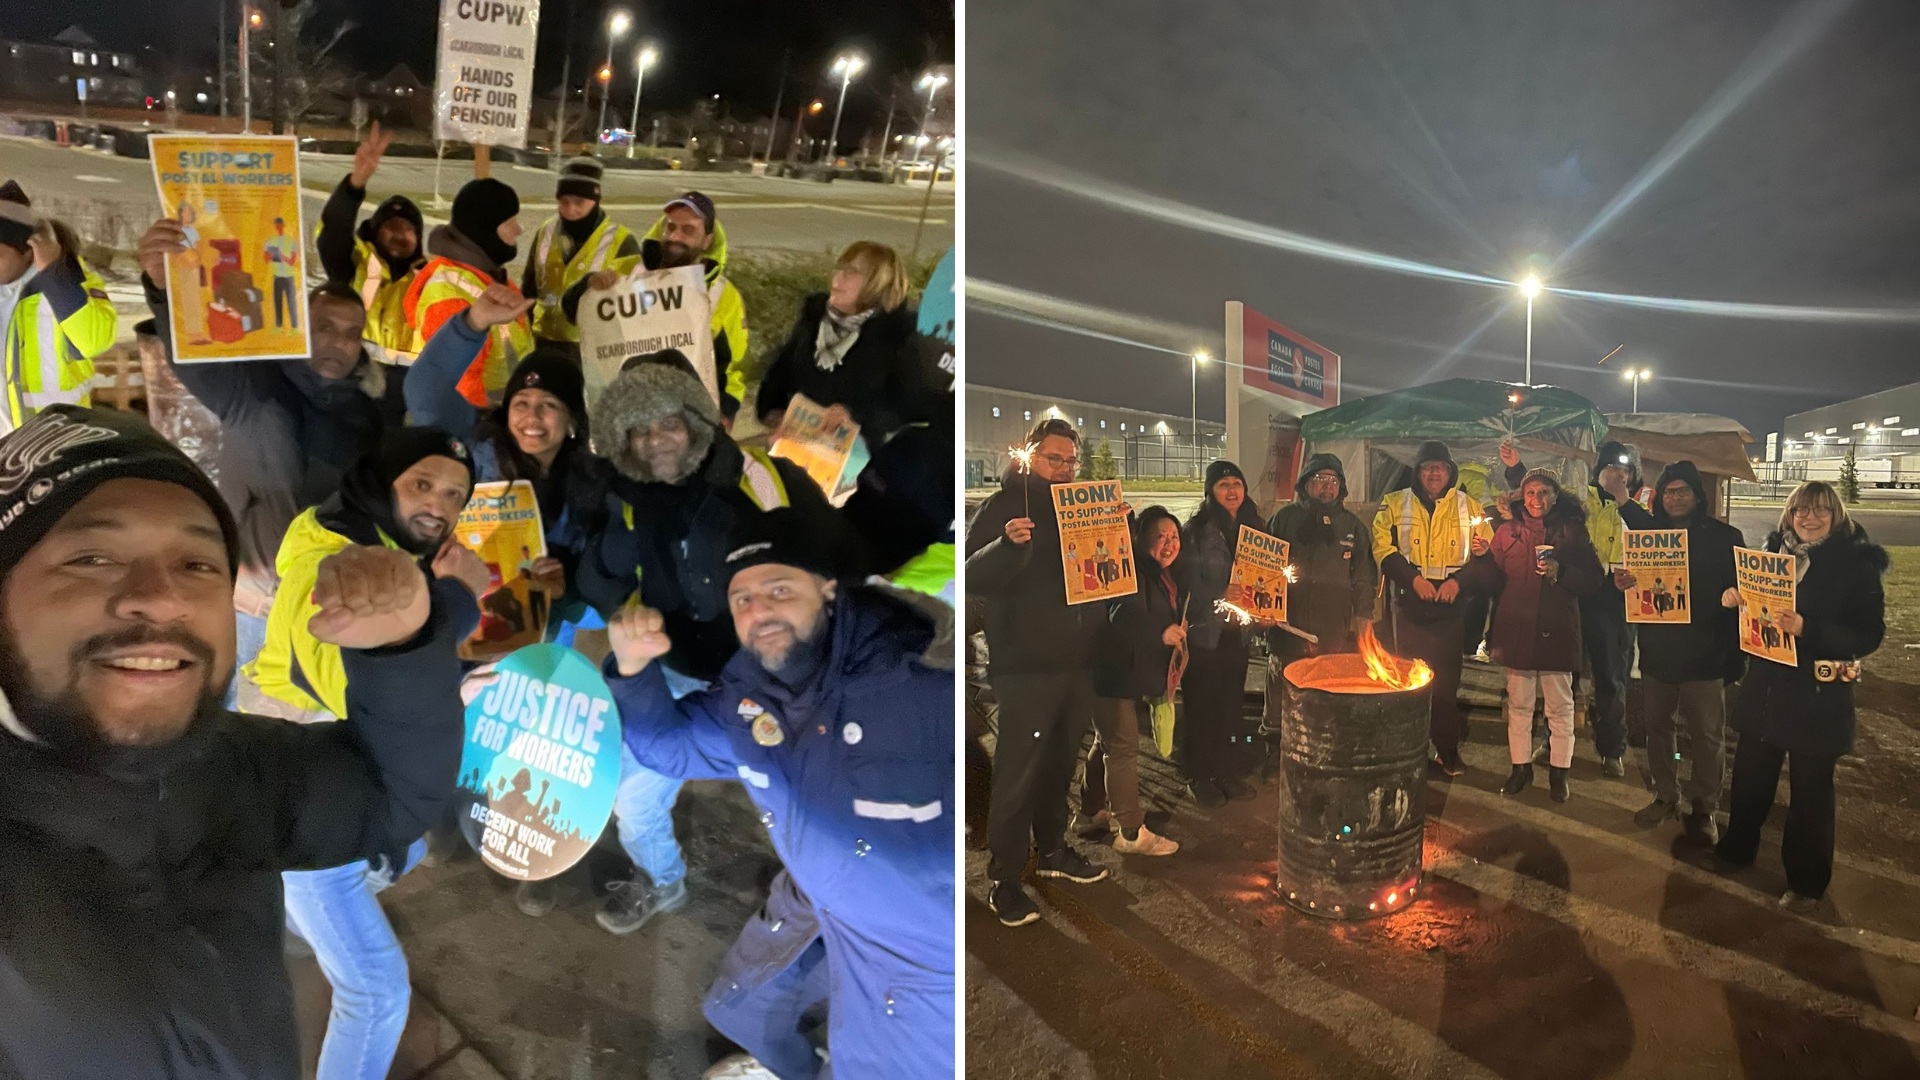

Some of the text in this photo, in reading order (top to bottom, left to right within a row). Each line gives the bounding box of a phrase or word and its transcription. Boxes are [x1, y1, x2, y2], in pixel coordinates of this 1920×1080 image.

[457, 0, 525, 26] CUPW
[460, 66, 514, 88] HANDS
[453, 85, 517, 109] OFF OUR
[450, 106, 516, 129] PENSION
[178, 151, 274, 169] SUPPORT
[162, 172, 294, 185] POSTAL WORKERS
[597, 285, 684, 321] CUPW
[596, 332, 695, 360] SCARBOROUGH LOCAL
[792, 405, 850, 441] HOK
[1058, 484, 1118, 507] HONK
[481, 508, 535, 523] WORKERS
[1059, 510, 1075, 521] TO
[1062, 515, 1125, 531] POSTAL WORKERS
[1239, 544, 1249, 554] TO
[1243, 530, 1286, 557] HONK
[1628, 533, 1683, 549] HONK
[1237, 553, 1258, 564] POSTAL
[1626, 551, 1686, 559] TO SUPPORT
[1738, 551, 1790, 577] HONK
[1738, 570, 1793, 590] TO SUPPORT
[1739, 580, 1759, 592] POSTAL
[1759, 586, 1792, 599] WORKERS
[482, 669, 610, 755] JUSTICE
[471, 715, 596, 789] FOR WORKERS
[470, 802, 557, 858] DECENT WORK
[482, 827, 508, 854] FOR
[506, 840, 530, 867] ALL
